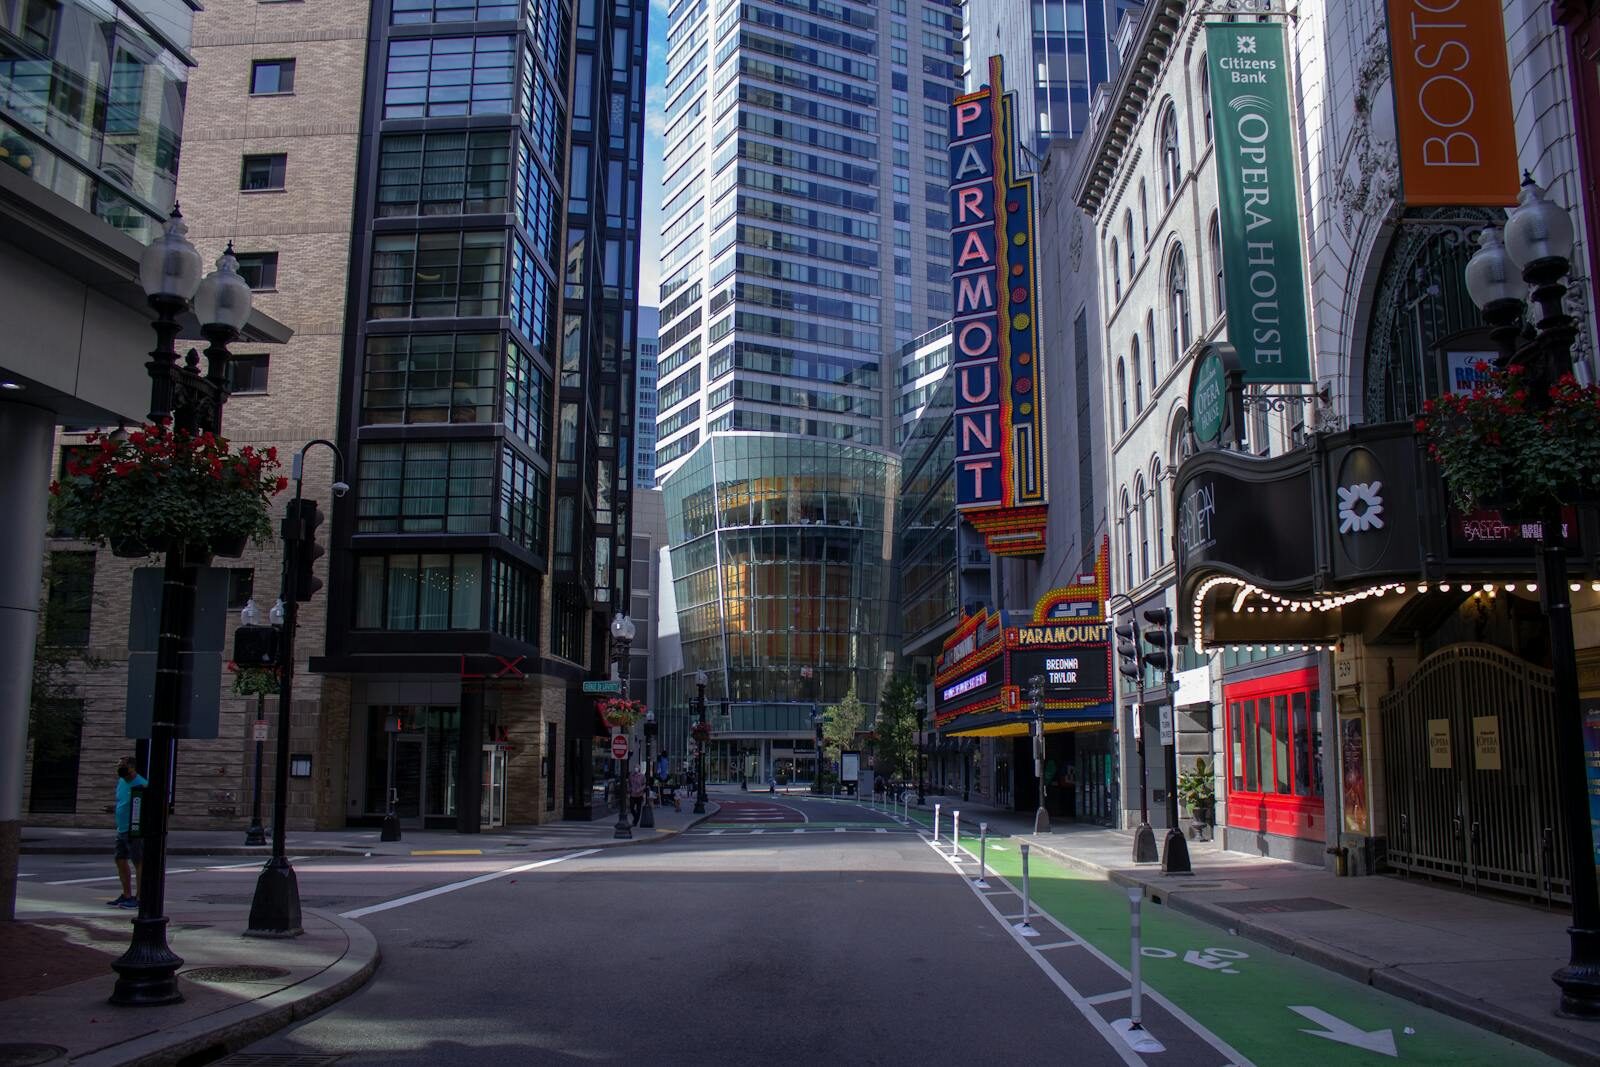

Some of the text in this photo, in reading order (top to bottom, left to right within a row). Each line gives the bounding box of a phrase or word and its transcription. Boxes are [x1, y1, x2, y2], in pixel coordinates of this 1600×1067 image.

[1219, 57, 1277, 70] Citizens
[1231, 71, 1267, 84] Bank
[1411, 0, 1480, 166] BOST
[1238, 113, 1283, 365] OPERA HOUSE
[955, 100, 993, 499] PARAMOUNT
[1198, 382, 1220, 414] OPERA
[1019, 625, 1109, 644] PARAMOUNT
[1046, 658, 1078, 671] BREONNA
[1339, 662, 1351, 677] 539
[1049, 672, 1077, 684] TAYLOR
